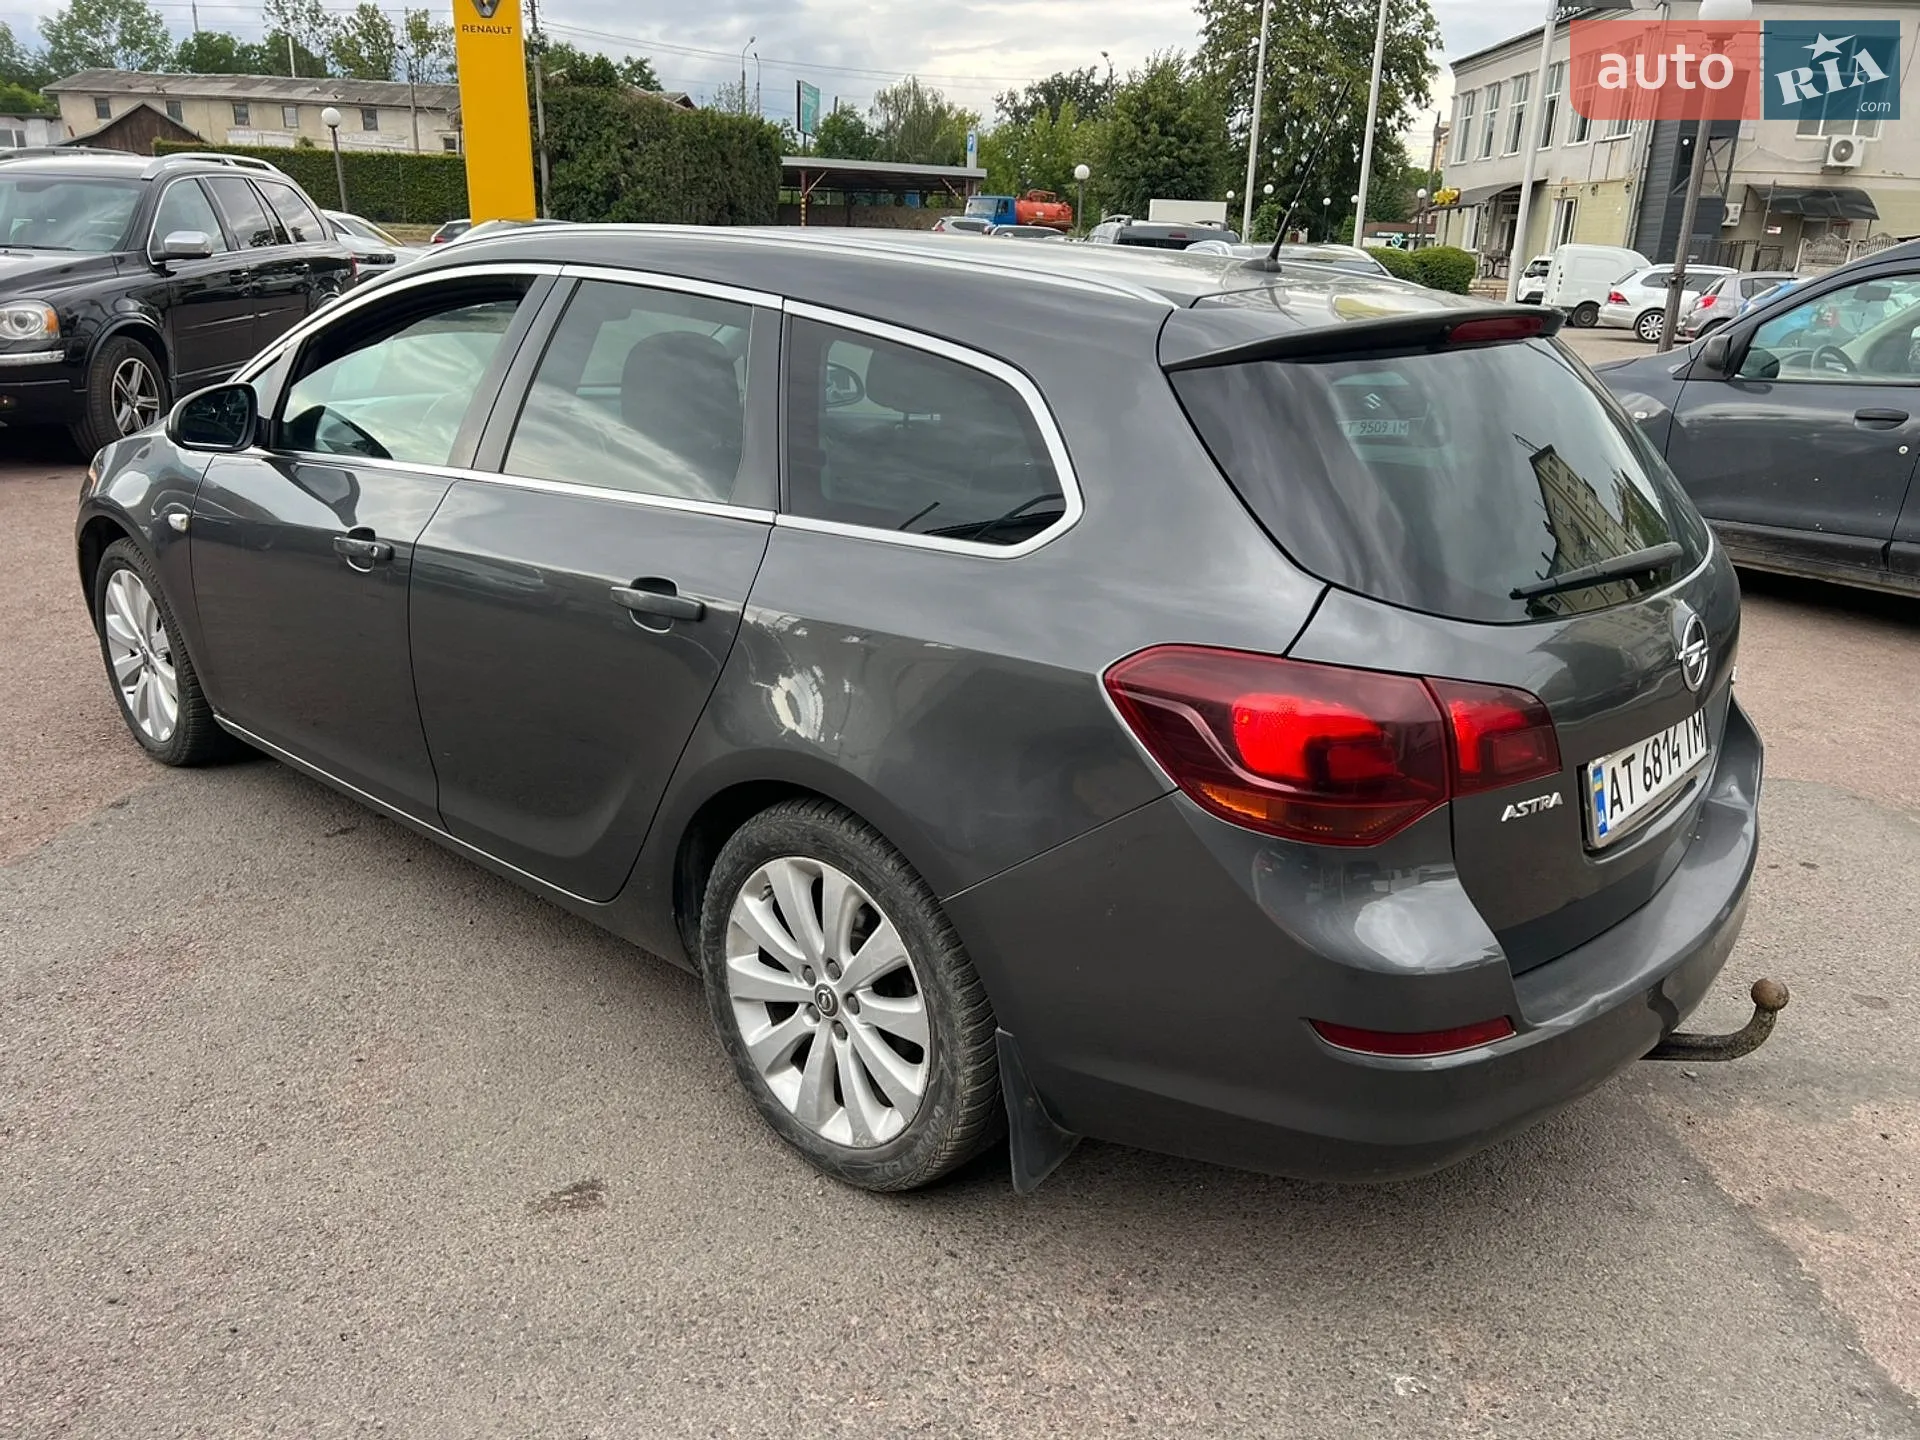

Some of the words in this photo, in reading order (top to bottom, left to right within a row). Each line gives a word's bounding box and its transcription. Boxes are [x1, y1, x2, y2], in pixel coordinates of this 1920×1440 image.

[462, 24, 512, 35] RENAULT
[1360, 421, 1389, 434] 9509
[1609, 752, 1636, 820] AT
[1642, 723, 1682, 793] 6814
[1684, 706, 1706, 761] IM
[1501, 792, 1564, 823] ASTRA
